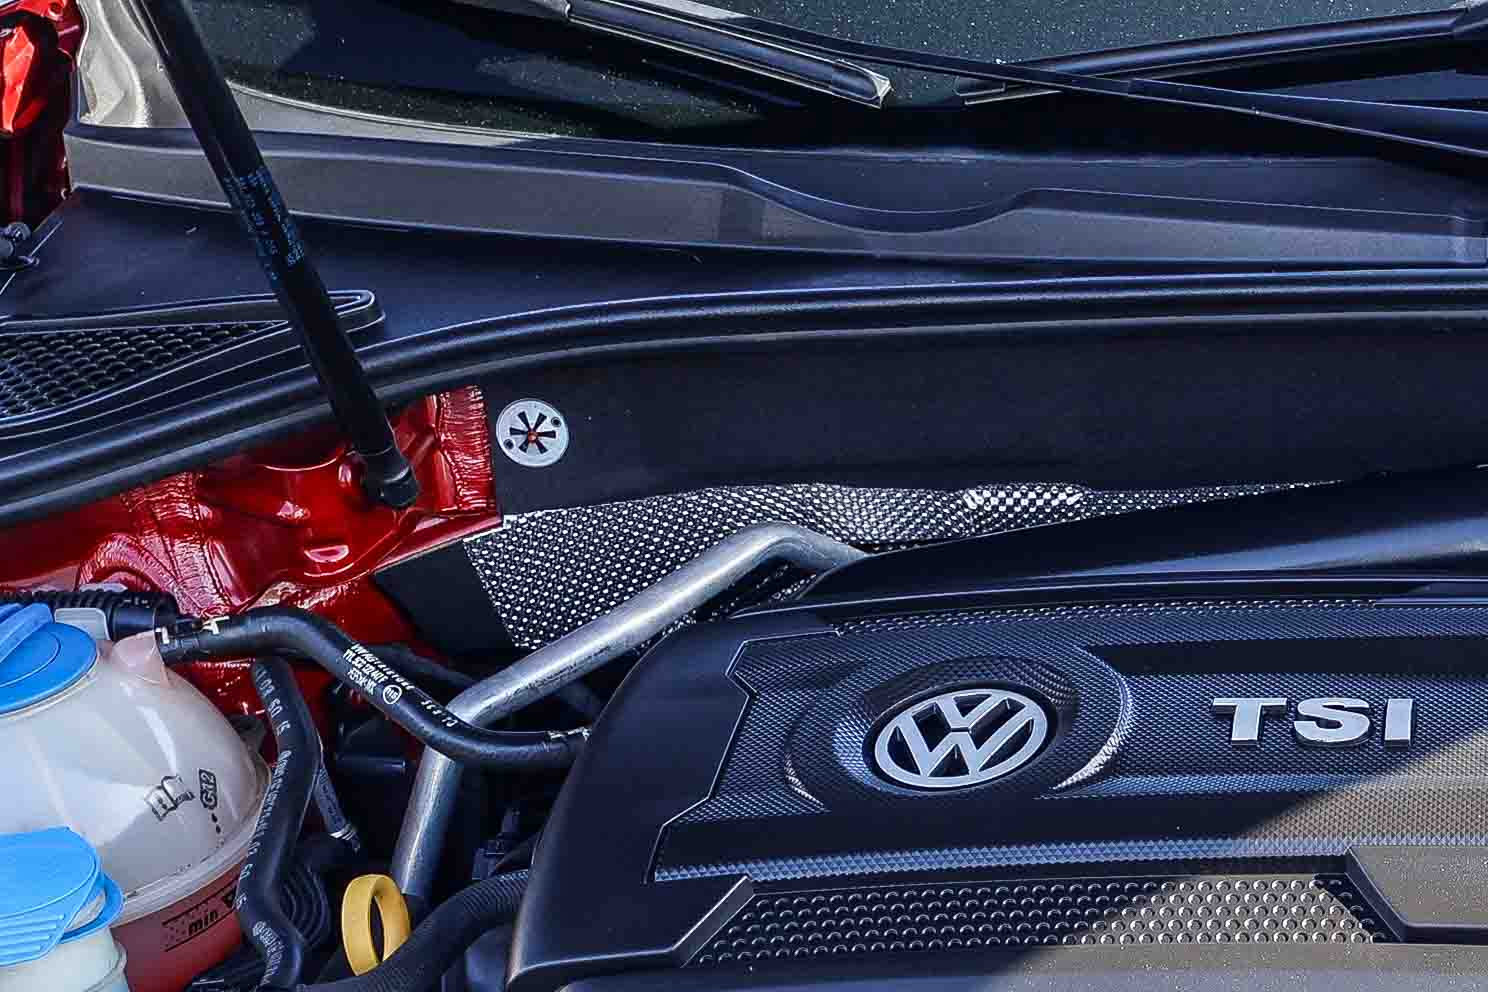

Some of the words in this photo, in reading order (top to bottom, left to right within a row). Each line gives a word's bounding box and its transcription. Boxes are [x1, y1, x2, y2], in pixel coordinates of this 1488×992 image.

[1211, 698, 1414, 746] TSI
[200, 769, 217, 810] G12
[188, 909, 219, 937] min
